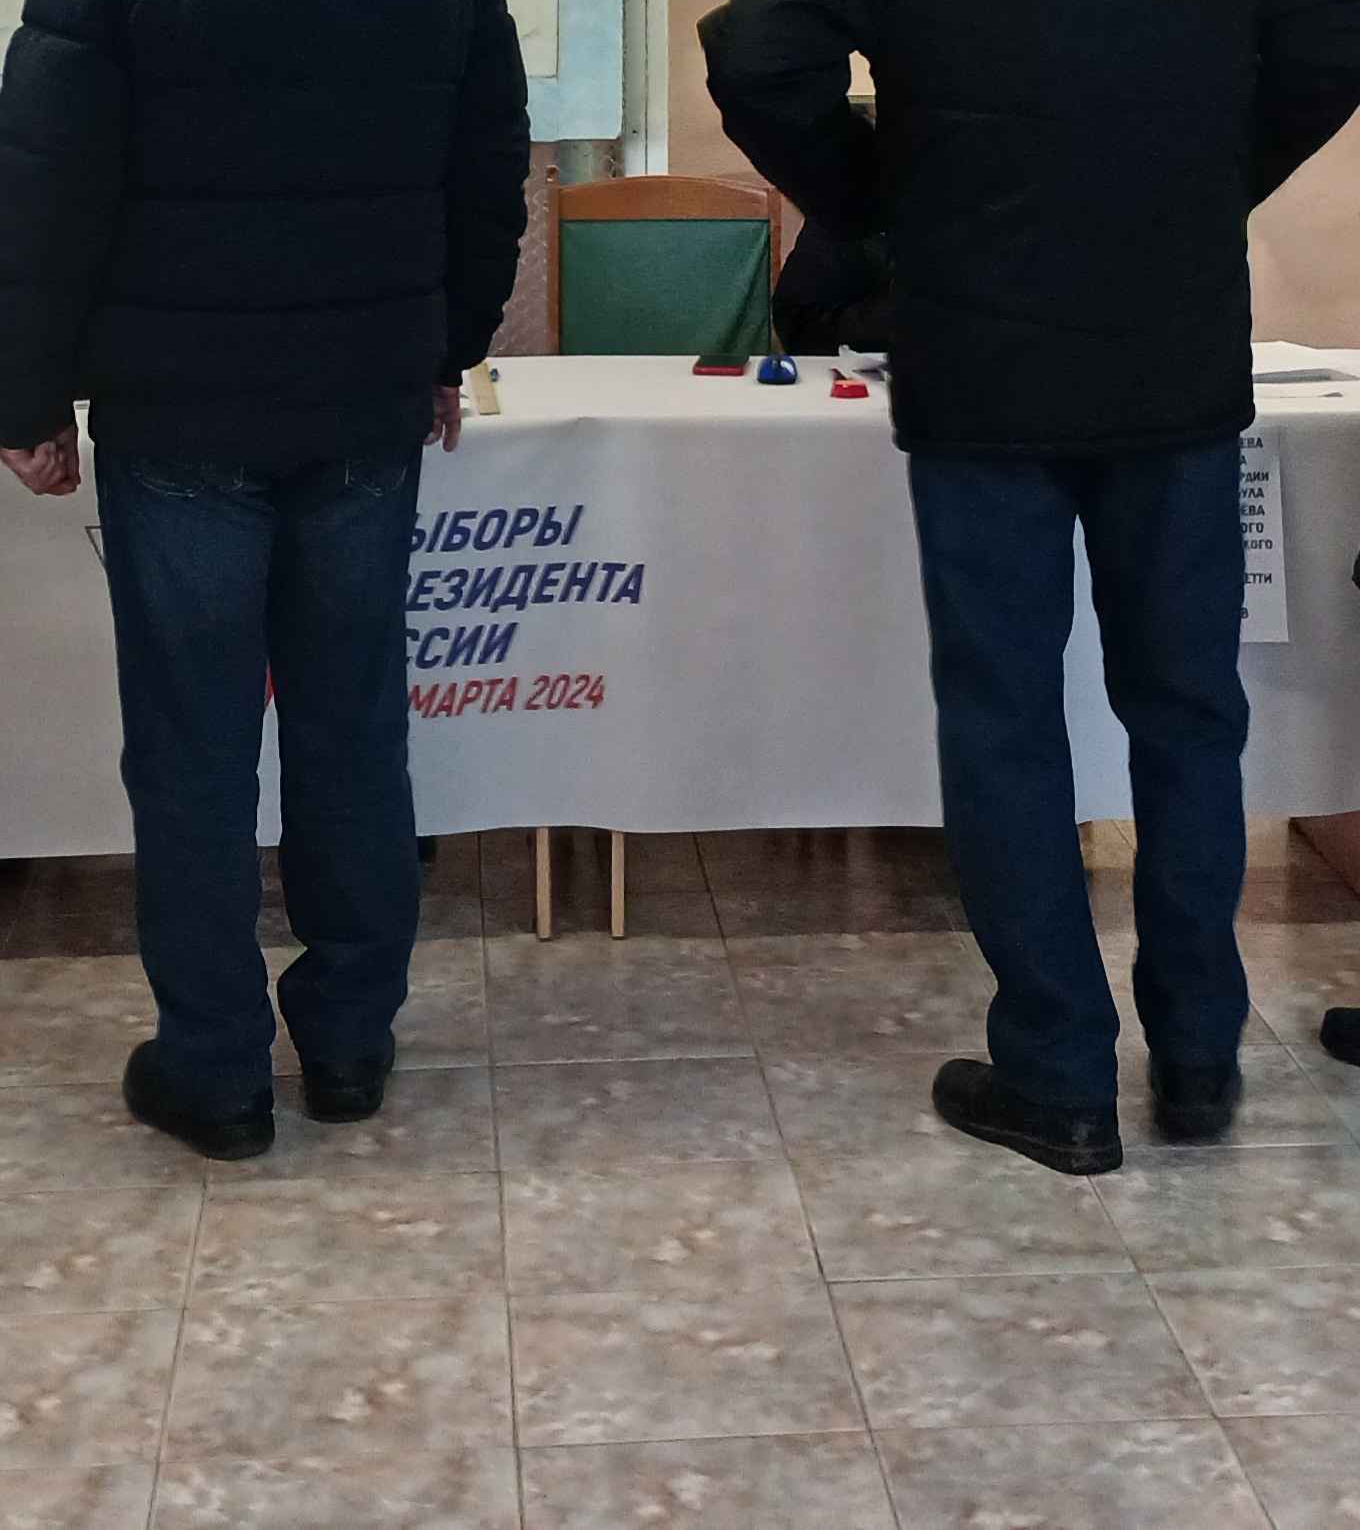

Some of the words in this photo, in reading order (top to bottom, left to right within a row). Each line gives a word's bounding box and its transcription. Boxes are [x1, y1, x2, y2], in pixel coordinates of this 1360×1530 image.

[409, 504, 584, 554] ЫБОРЫ
[405, 562, 645, 613] ЕЗИДЕНТА
[409, 676, 519, 719] МАРТА
[524, 674, 606, 711] 2024
